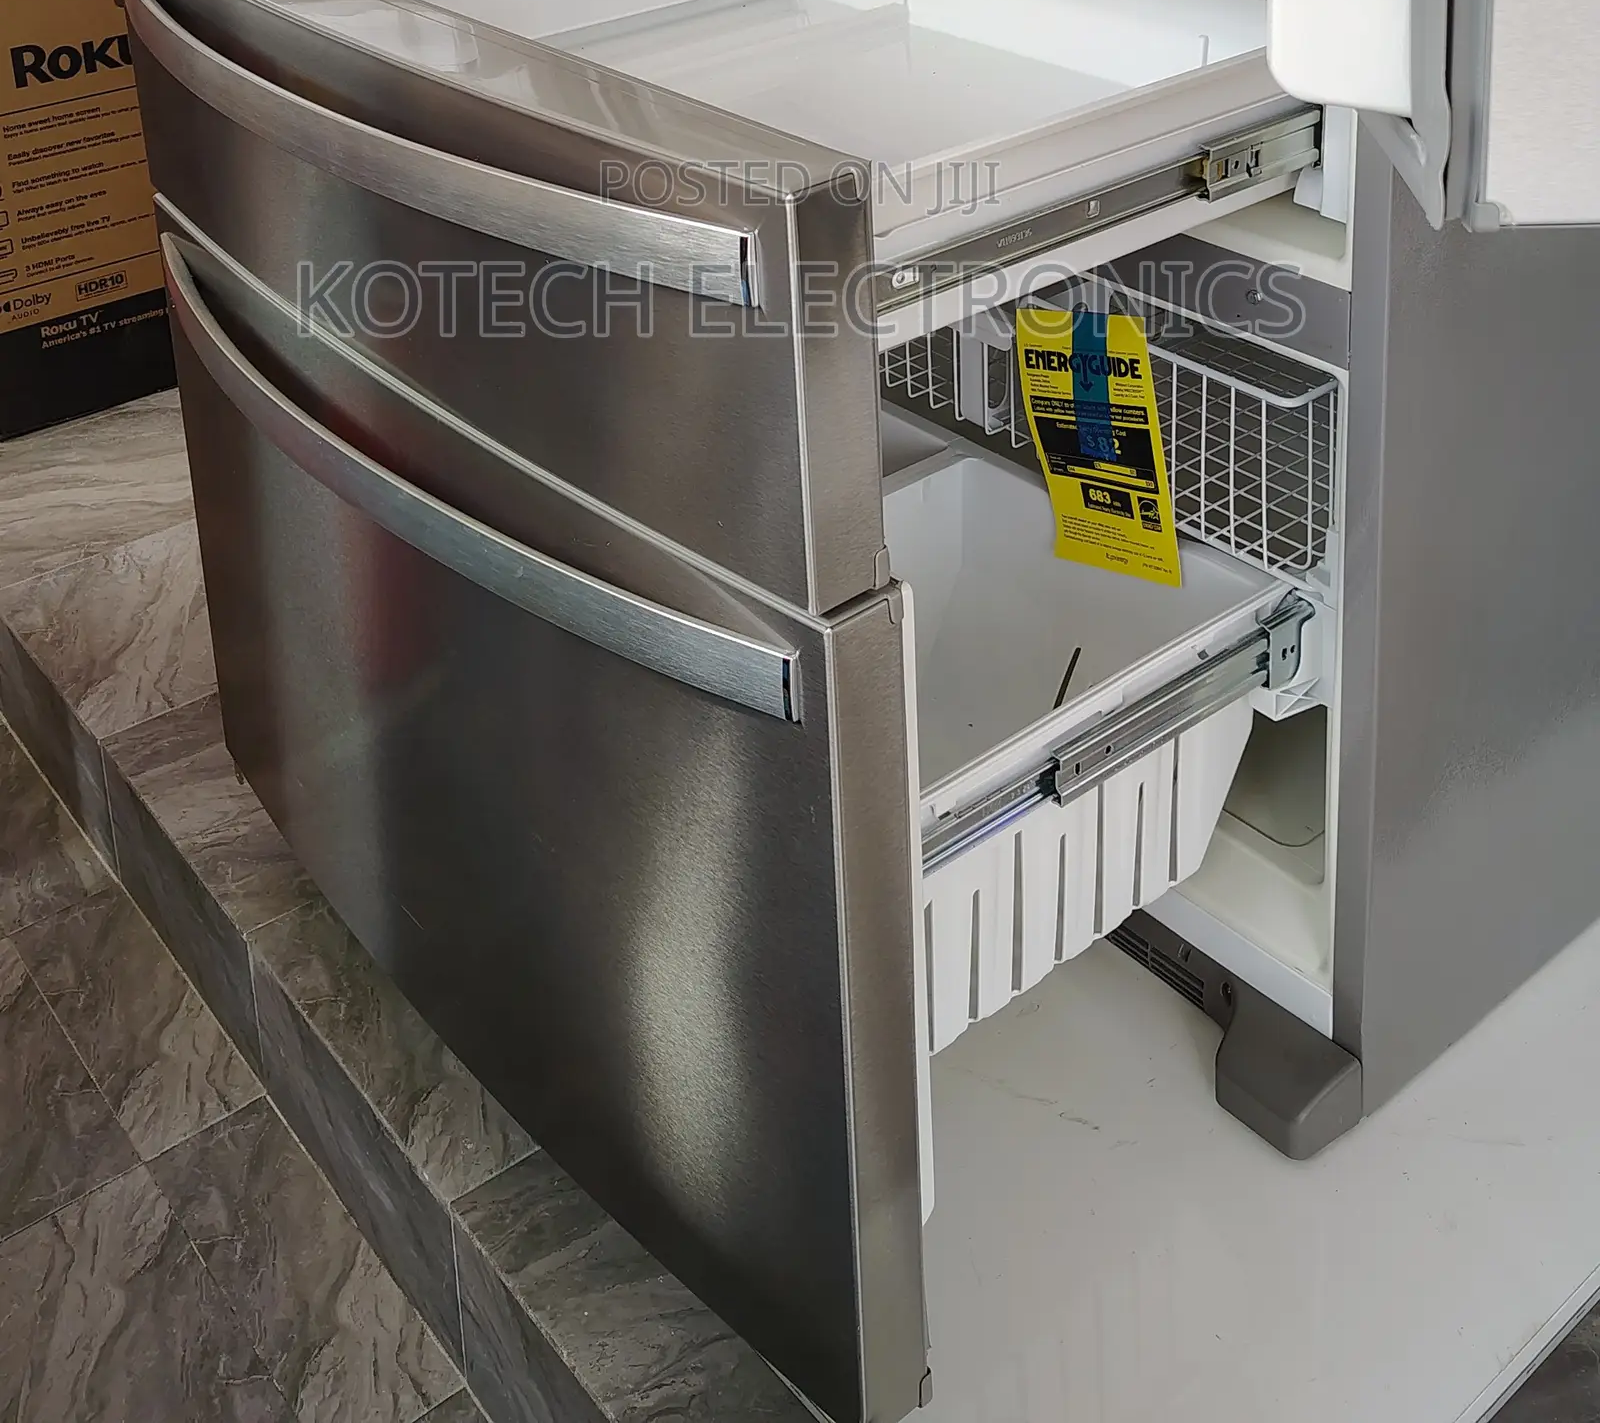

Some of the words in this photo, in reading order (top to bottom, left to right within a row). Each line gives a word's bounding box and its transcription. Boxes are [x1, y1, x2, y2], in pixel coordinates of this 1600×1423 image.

[3, 121, 26, 133] Home
[27, 117, 51, 127] sweet
[52, 113, 74, 123] home
[75, 106, 101, 116] screen
[8, 150, 30, 162] Easily
[32, 142, 65, 156] discover
[65, 139, 82, 147] new
[83, 131, 116, 144] favorites
[12, 178, 29, 188] Find
[31, 169, 71, 185] something
[71, 166, 80, 175] to
[81, 161, 104, 172] watch
[17, 206, 44, 217] Always
[45, 201, 63, 210] easy
[76, 193, 88, 201] the
[89, 189, 107, 199] eyes
[21, 226, 69, 244] Unbelievably
[70, 222, 85, 232] free
[87, 219, 100, 228] live
[101, 215, 111, 223] TV
[32, 259, 54, 270] HDMI
[55, 254, 76, 264] Ports
[77, 273, 125, 296] HDR10
[11, 308, 40, 321] AUDIO
[13, 292, 52, 310] Dolby
[41, 330, 89, 349] America's
[103, 320, 116, 331] TV
[118, 308, 164, 327] streaming
[1088, 488, 1111, 504] 683
